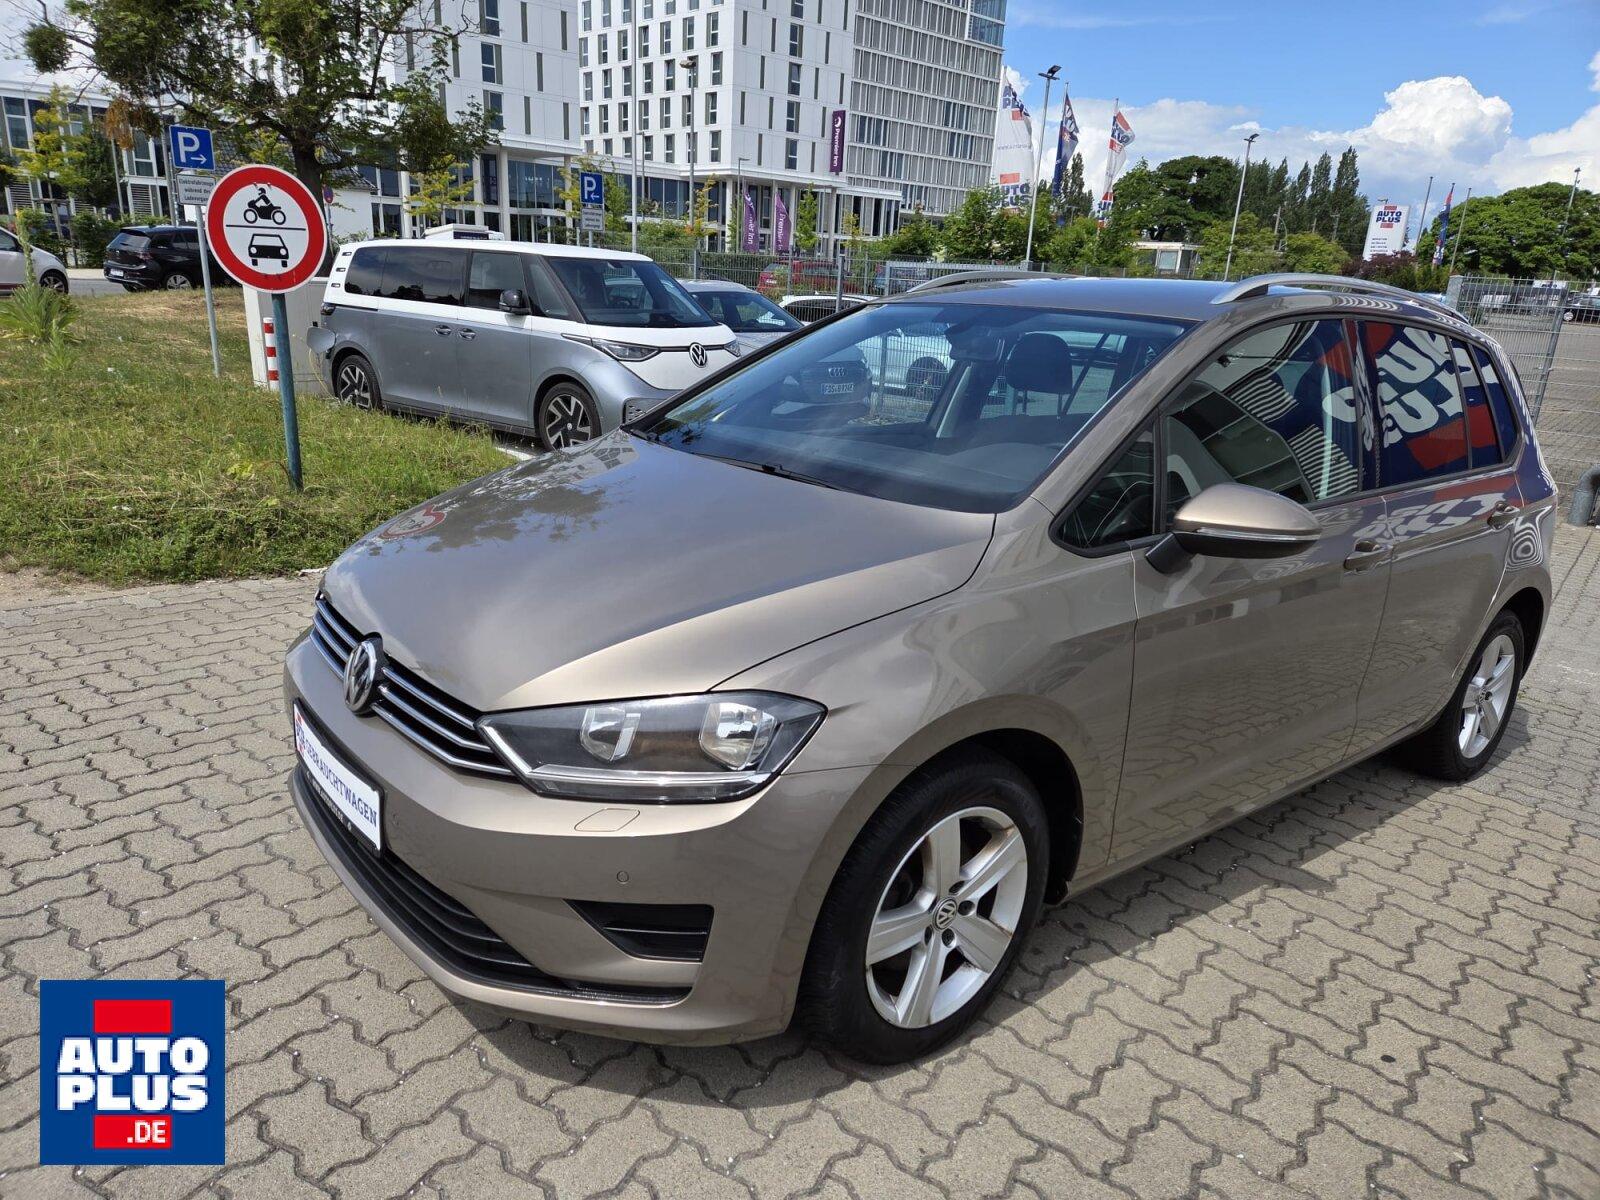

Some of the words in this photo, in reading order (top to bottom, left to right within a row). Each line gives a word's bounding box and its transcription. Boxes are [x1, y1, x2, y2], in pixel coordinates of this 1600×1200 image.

[177, 131, 200, 163] P
[583, 176, 597, 200] P
[304, 738, 378, 829] GEBRAUCHTWAGEN
